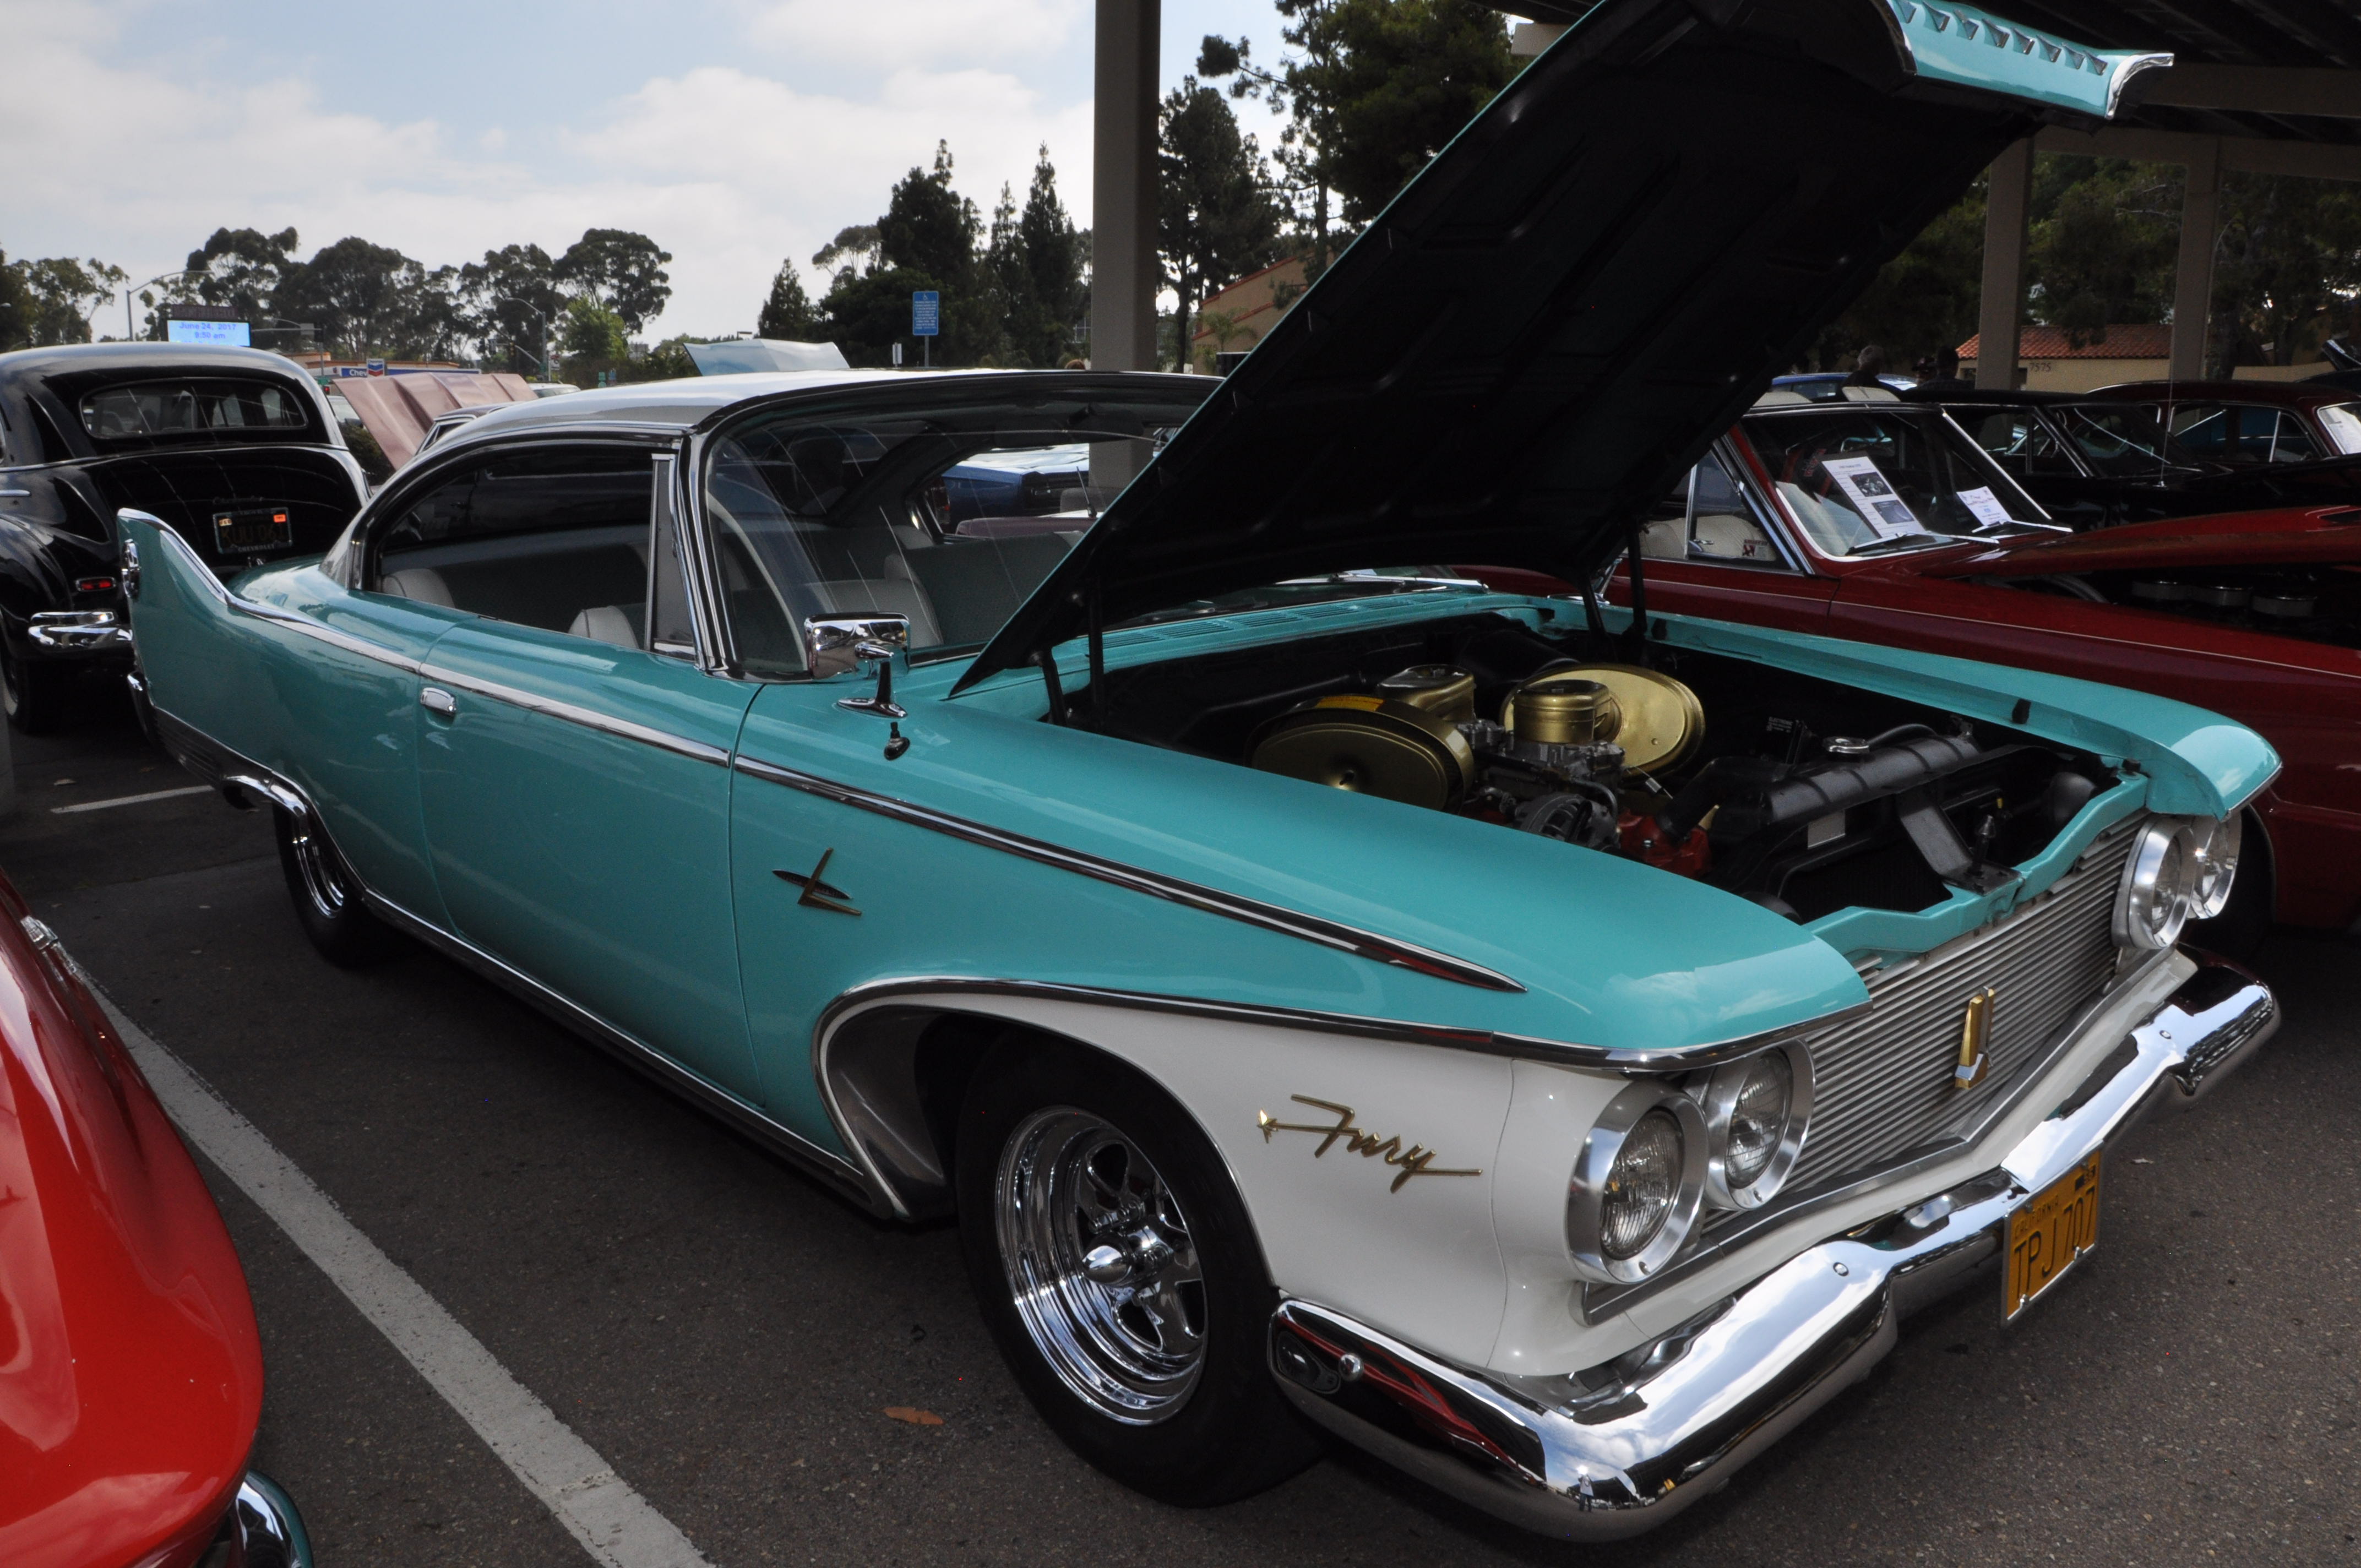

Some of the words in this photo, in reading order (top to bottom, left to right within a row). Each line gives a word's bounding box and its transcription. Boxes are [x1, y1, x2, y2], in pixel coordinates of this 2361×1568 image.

[1258, 1093, 1483, 1195] Fury
[2014, 1217, 2057, 1300] TPJ
[2063, 1185, 2096, 1260] 707
[2015, 1195, 2059, 1239] CALIFORNIA
